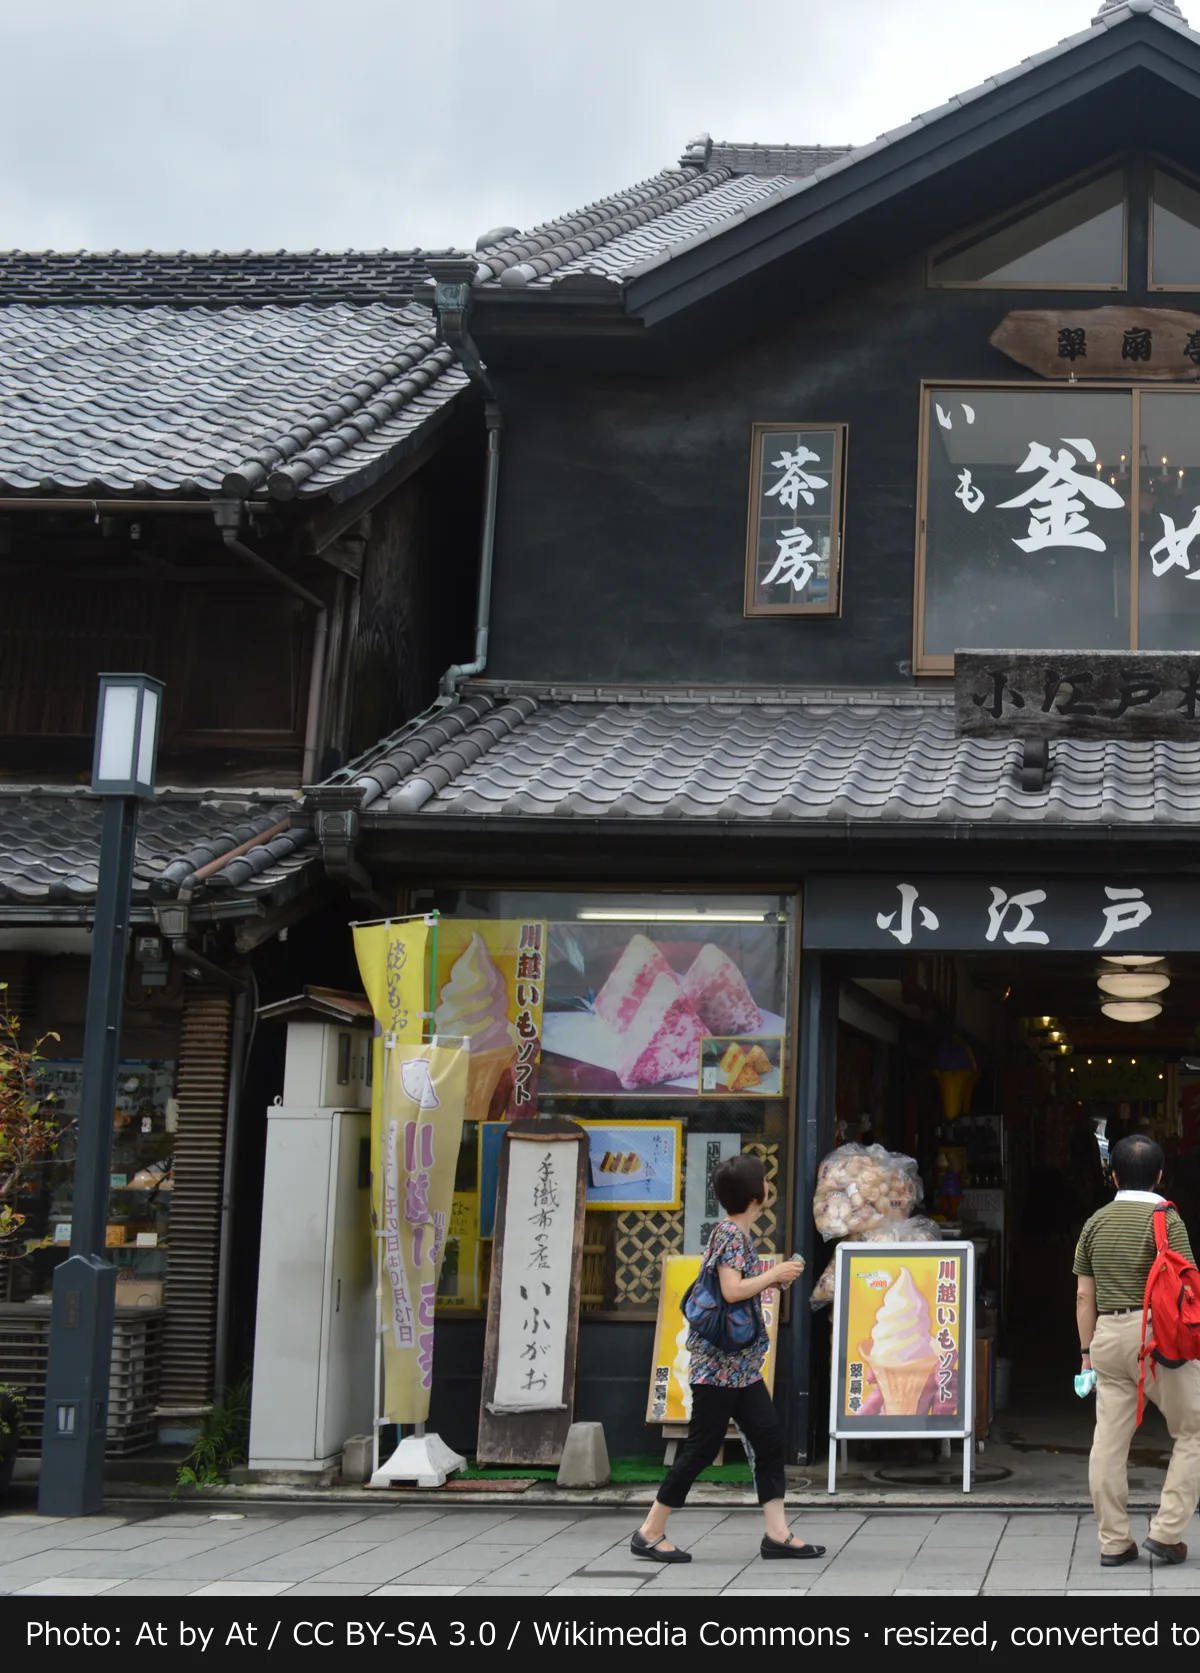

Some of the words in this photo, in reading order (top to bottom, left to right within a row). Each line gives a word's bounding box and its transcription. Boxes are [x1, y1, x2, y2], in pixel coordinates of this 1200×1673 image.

[761, 445, 829, 593] 茶房
[514, 921, 544, 1107] 川越いもソフト
[936, 1259, 958, 1402] 川越いもソフト
